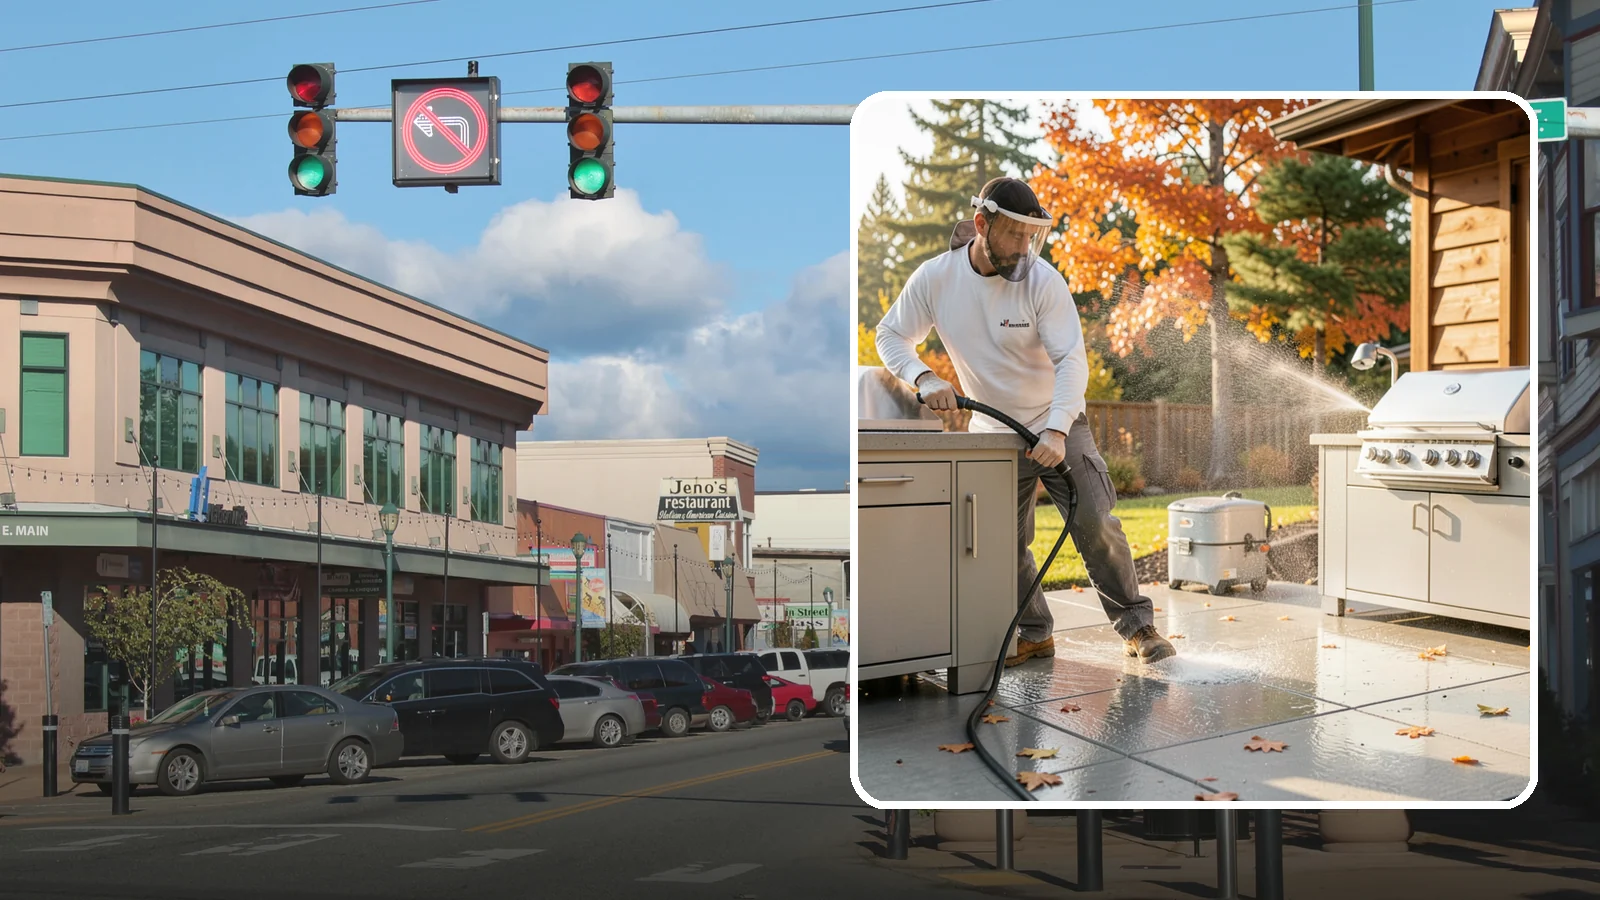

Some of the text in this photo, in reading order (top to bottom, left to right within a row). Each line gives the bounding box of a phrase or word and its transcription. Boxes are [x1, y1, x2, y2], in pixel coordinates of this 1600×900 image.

[670, 480, 727, 494] Jeno's
[665, 496, 731, 509] restaurant
[686, 510, 714, 519] American
[715, 509, 738, 519] Cuisine
[2, 525, 49, 536] E. MAIN
[797, 607, 829, 617] Street
